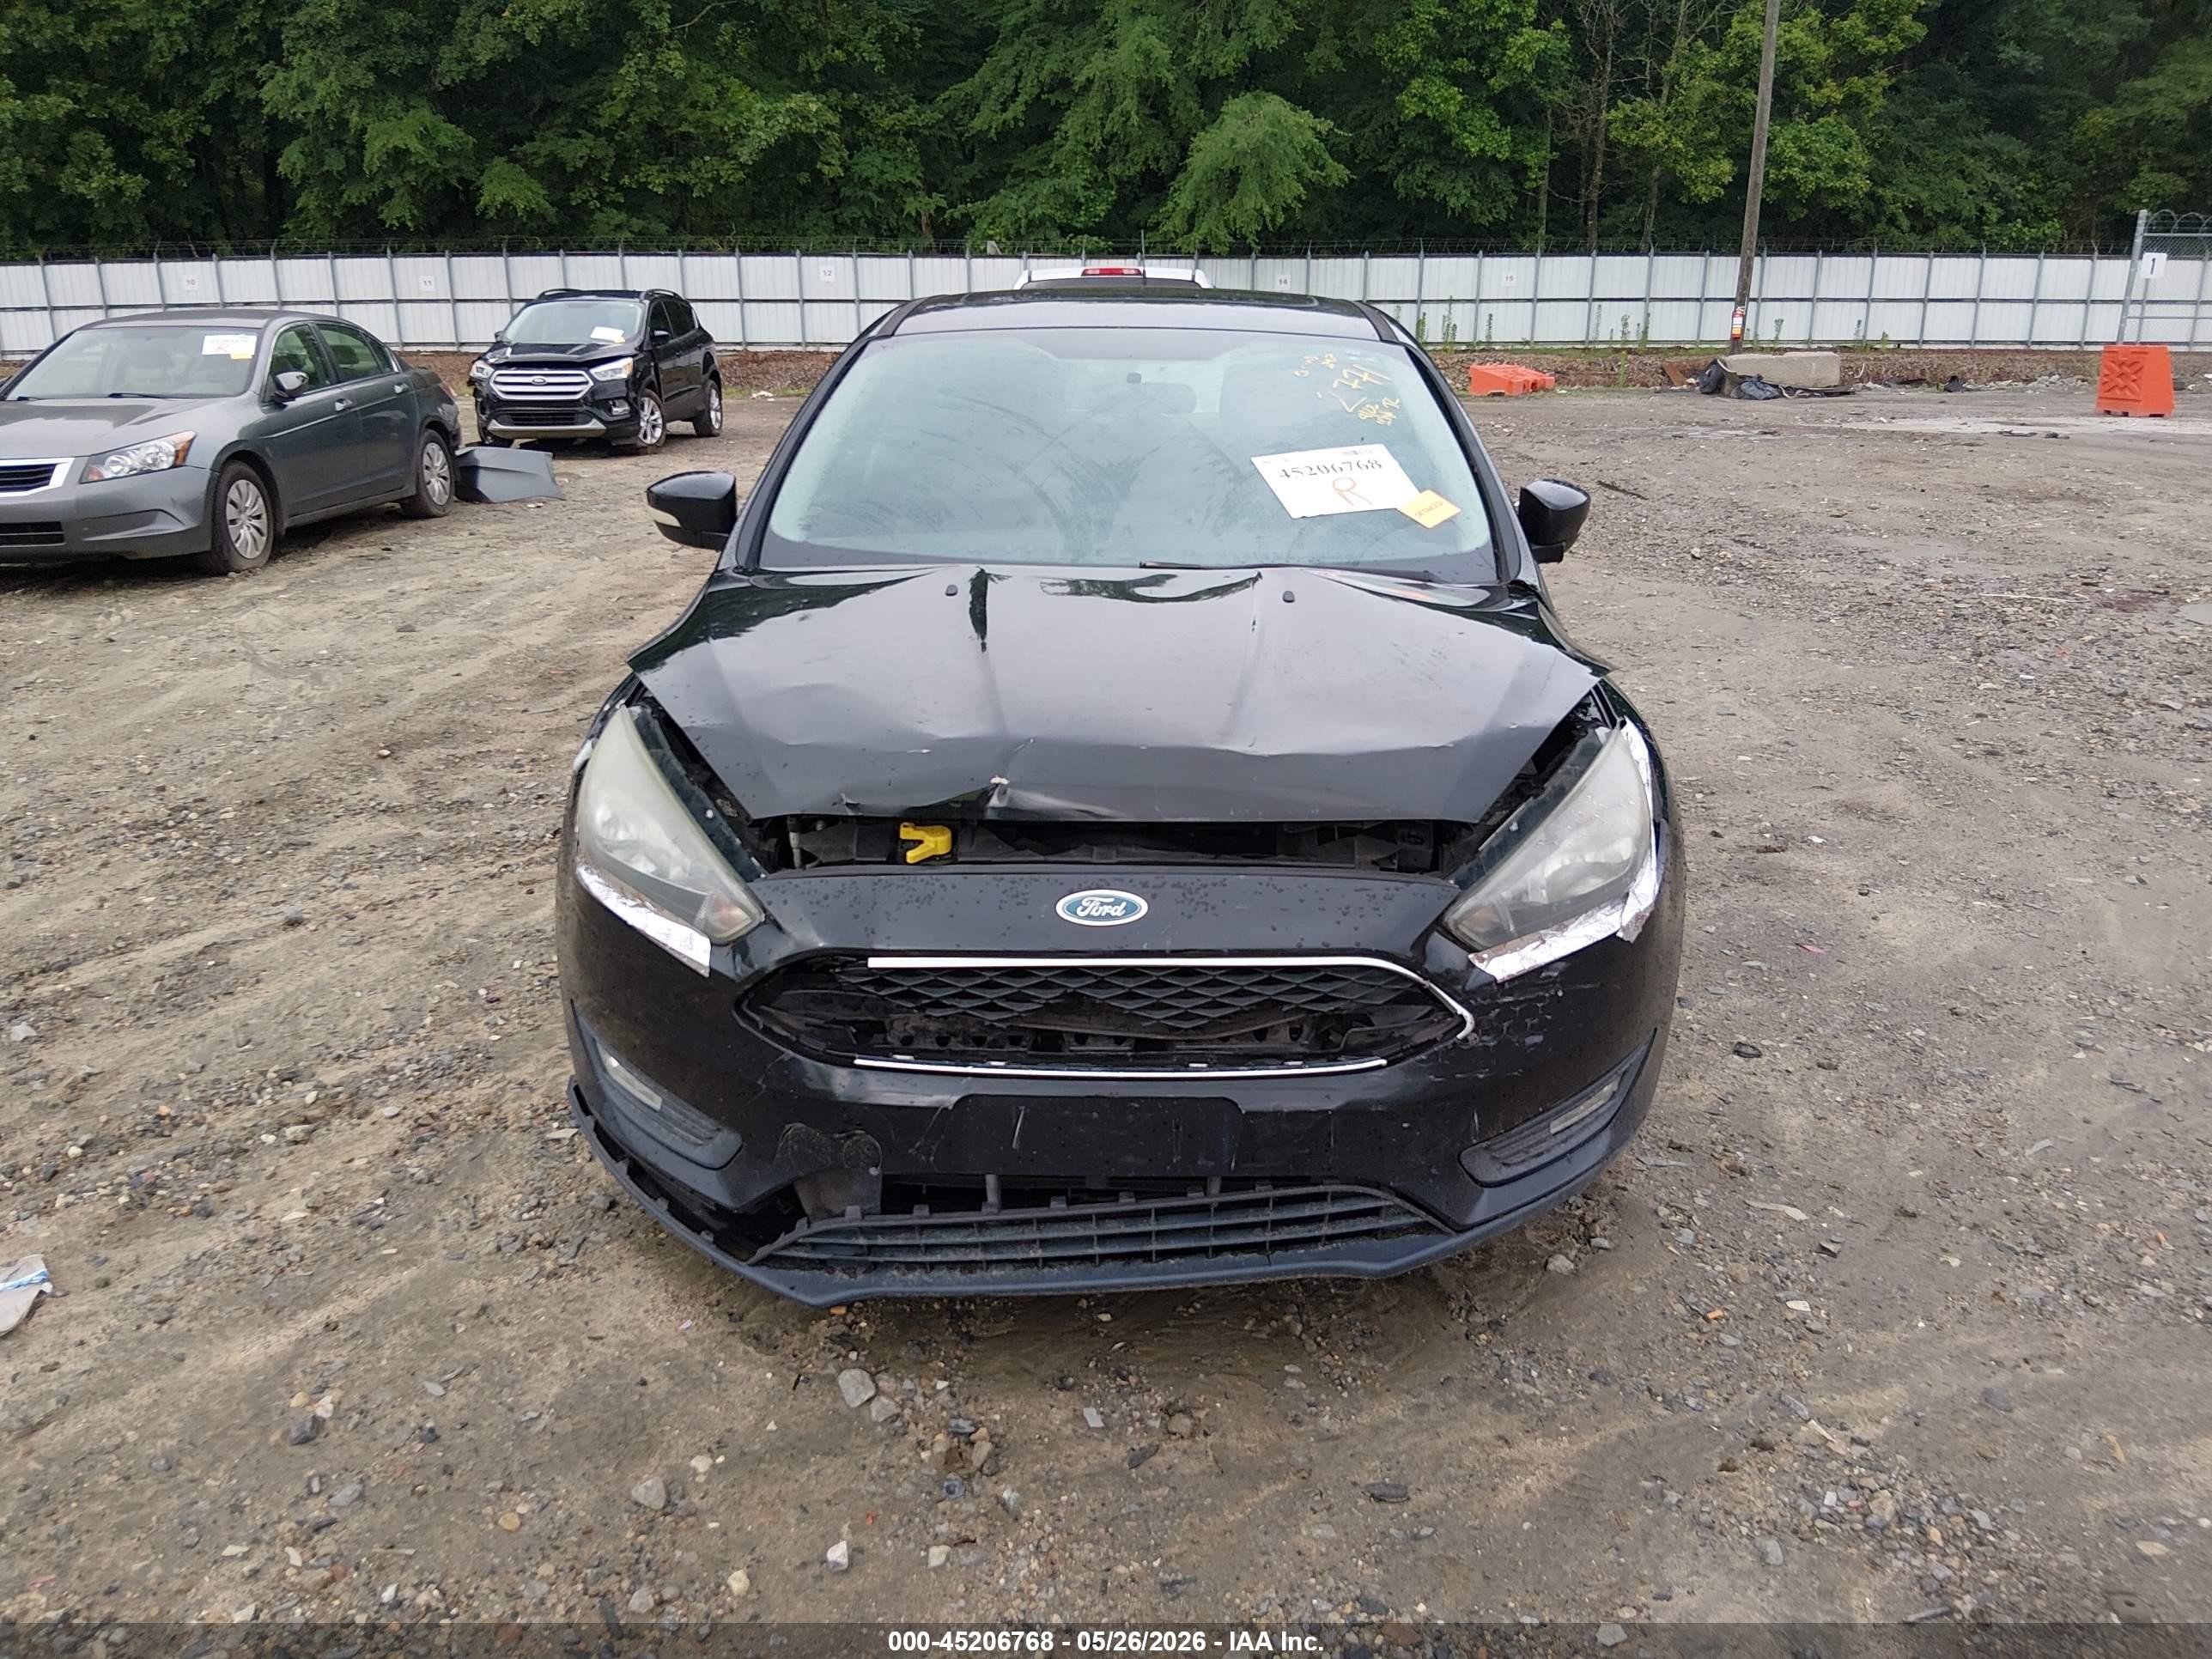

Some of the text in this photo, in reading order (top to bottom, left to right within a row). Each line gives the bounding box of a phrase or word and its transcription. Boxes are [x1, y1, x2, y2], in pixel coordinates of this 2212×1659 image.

[2149, 257, 2156, 275] 1
[1279, 459, 1383, 479] 45206768
[1076, 896, 1127, 917] Ford
